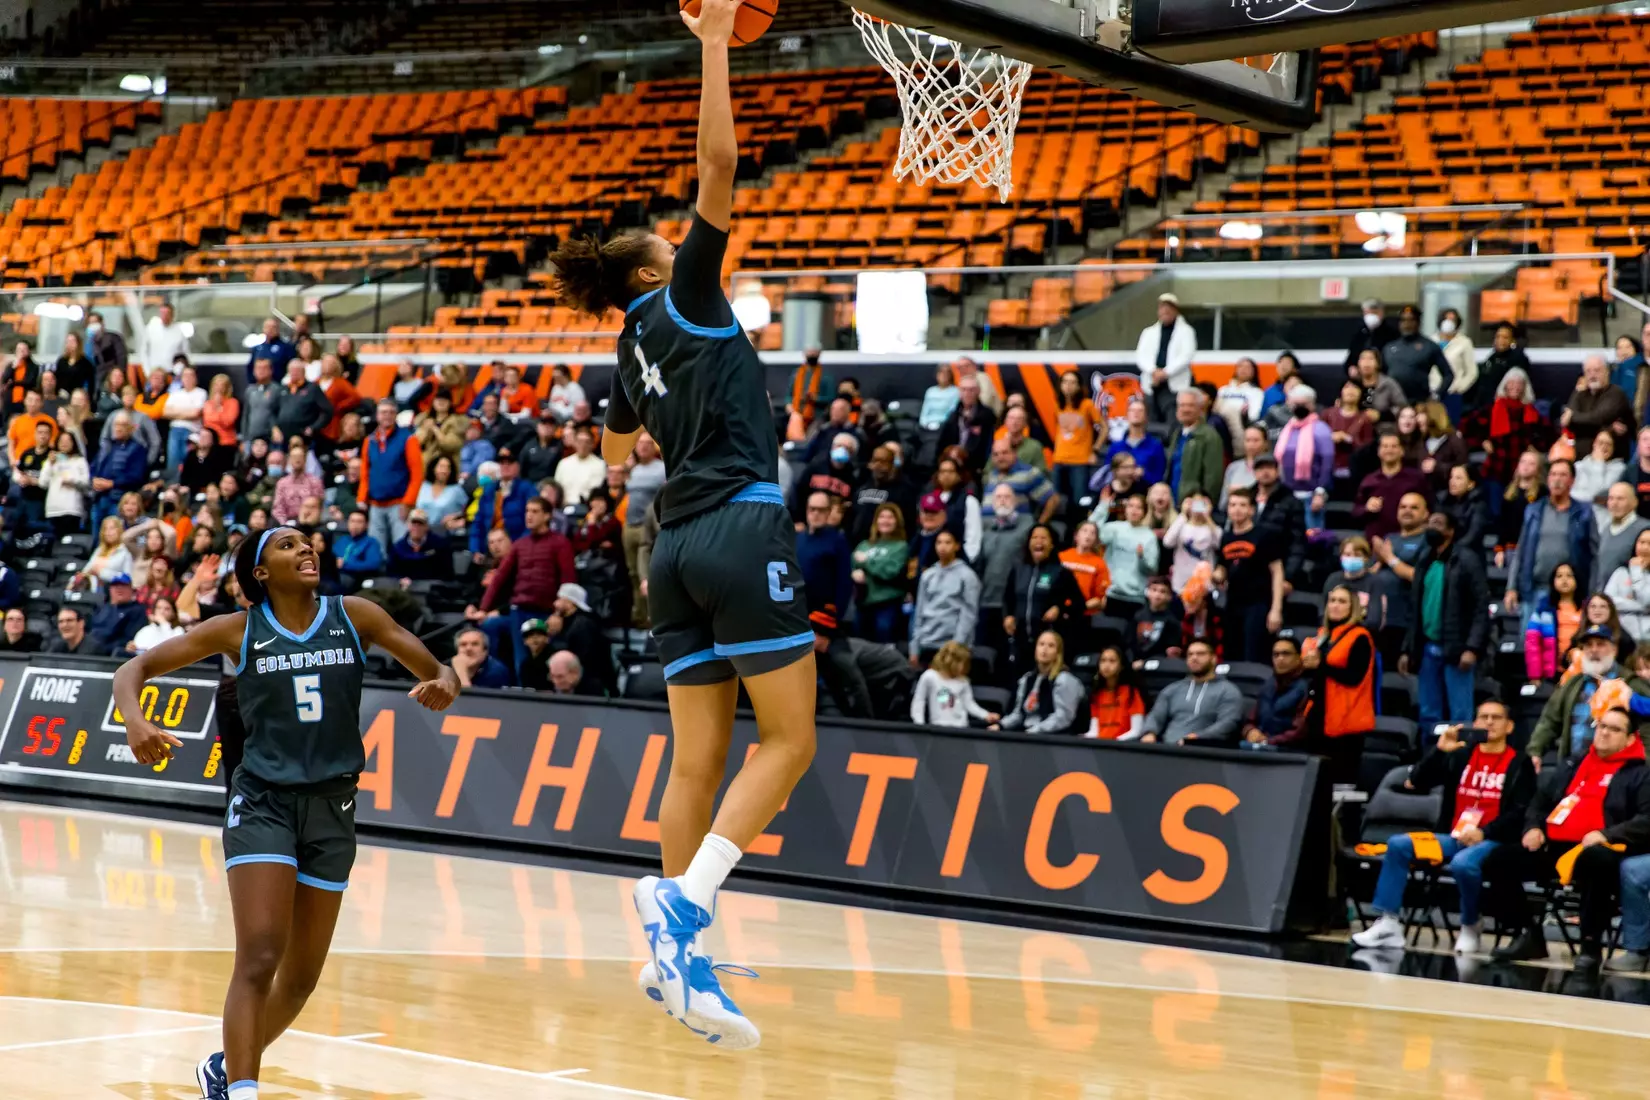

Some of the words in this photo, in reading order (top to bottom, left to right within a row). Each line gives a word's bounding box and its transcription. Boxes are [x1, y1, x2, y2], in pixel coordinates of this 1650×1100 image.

[766, 561, 794, 602] C
[256, 648, 355, 674] COLUMBIA
[31, 676, 83, 704] HOME
[292, 673, 324, 723] 5
[22, 715, 66, 756] 55
